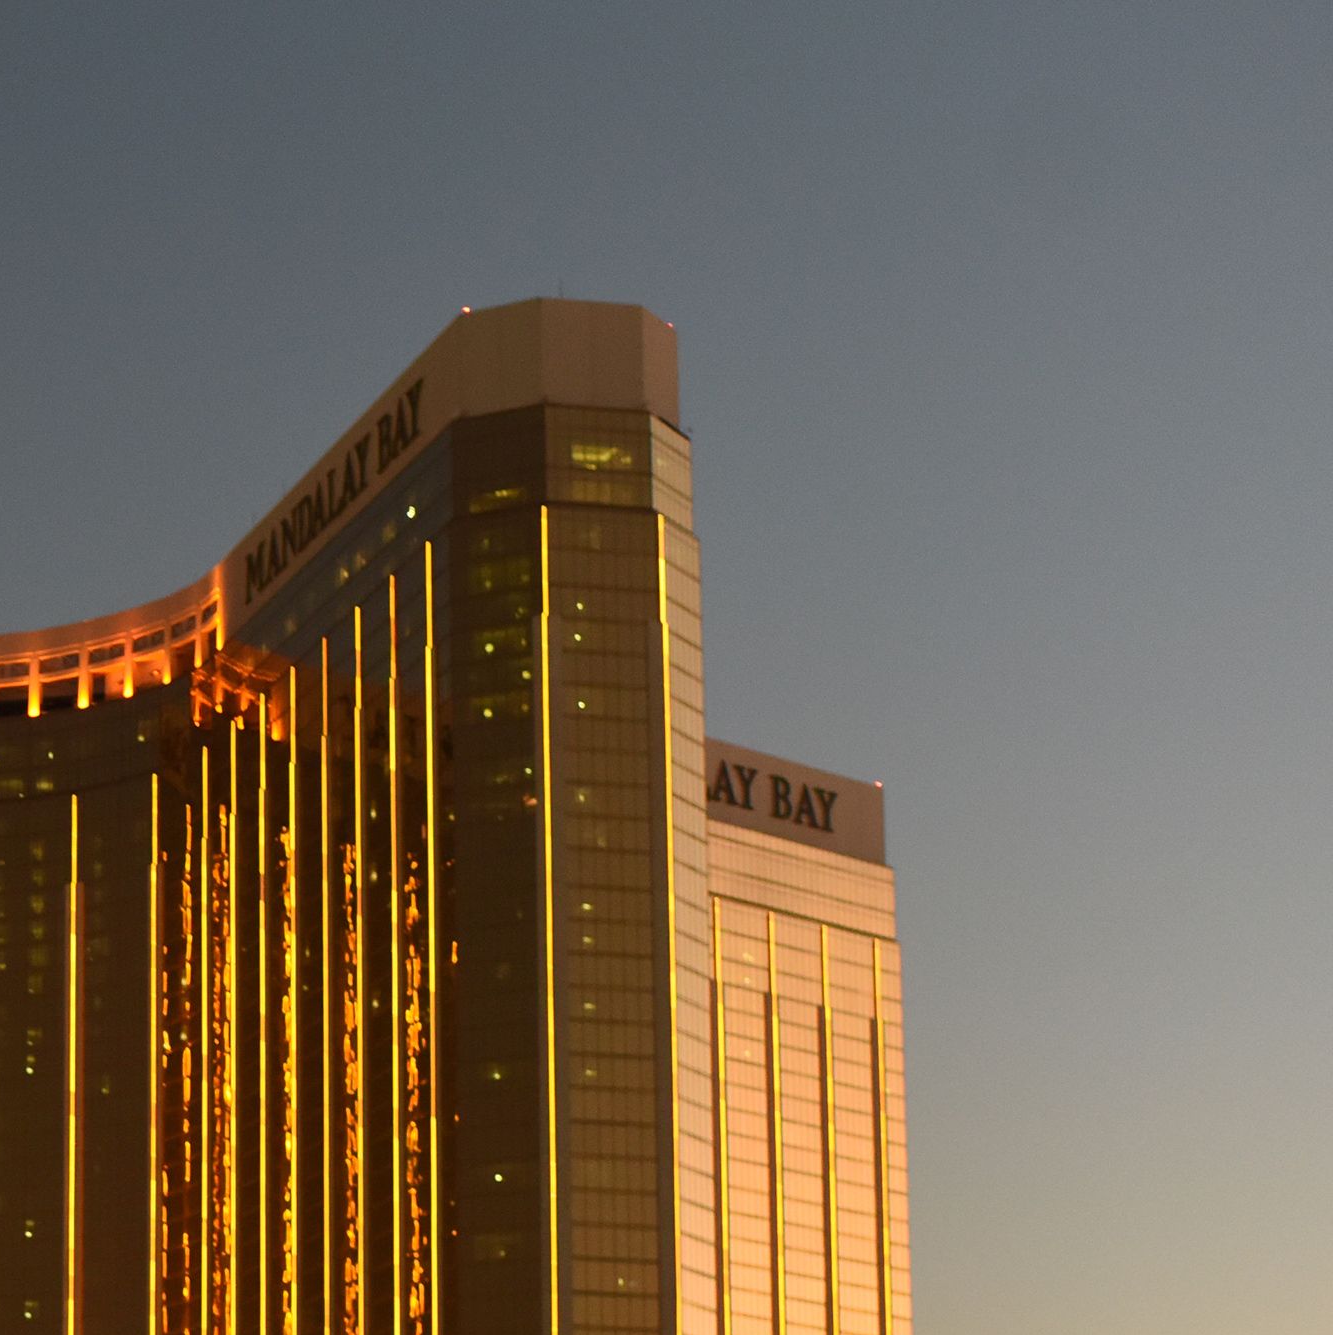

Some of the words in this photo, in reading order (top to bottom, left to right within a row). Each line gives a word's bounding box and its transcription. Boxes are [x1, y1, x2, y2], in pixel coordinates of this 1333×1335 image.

[245, 432, 370, 605] MANDALAY
[377, 378, 423, 475] BAY
[707, 759, 757, 810] AY
[771, 774, 838, 833] BAY
